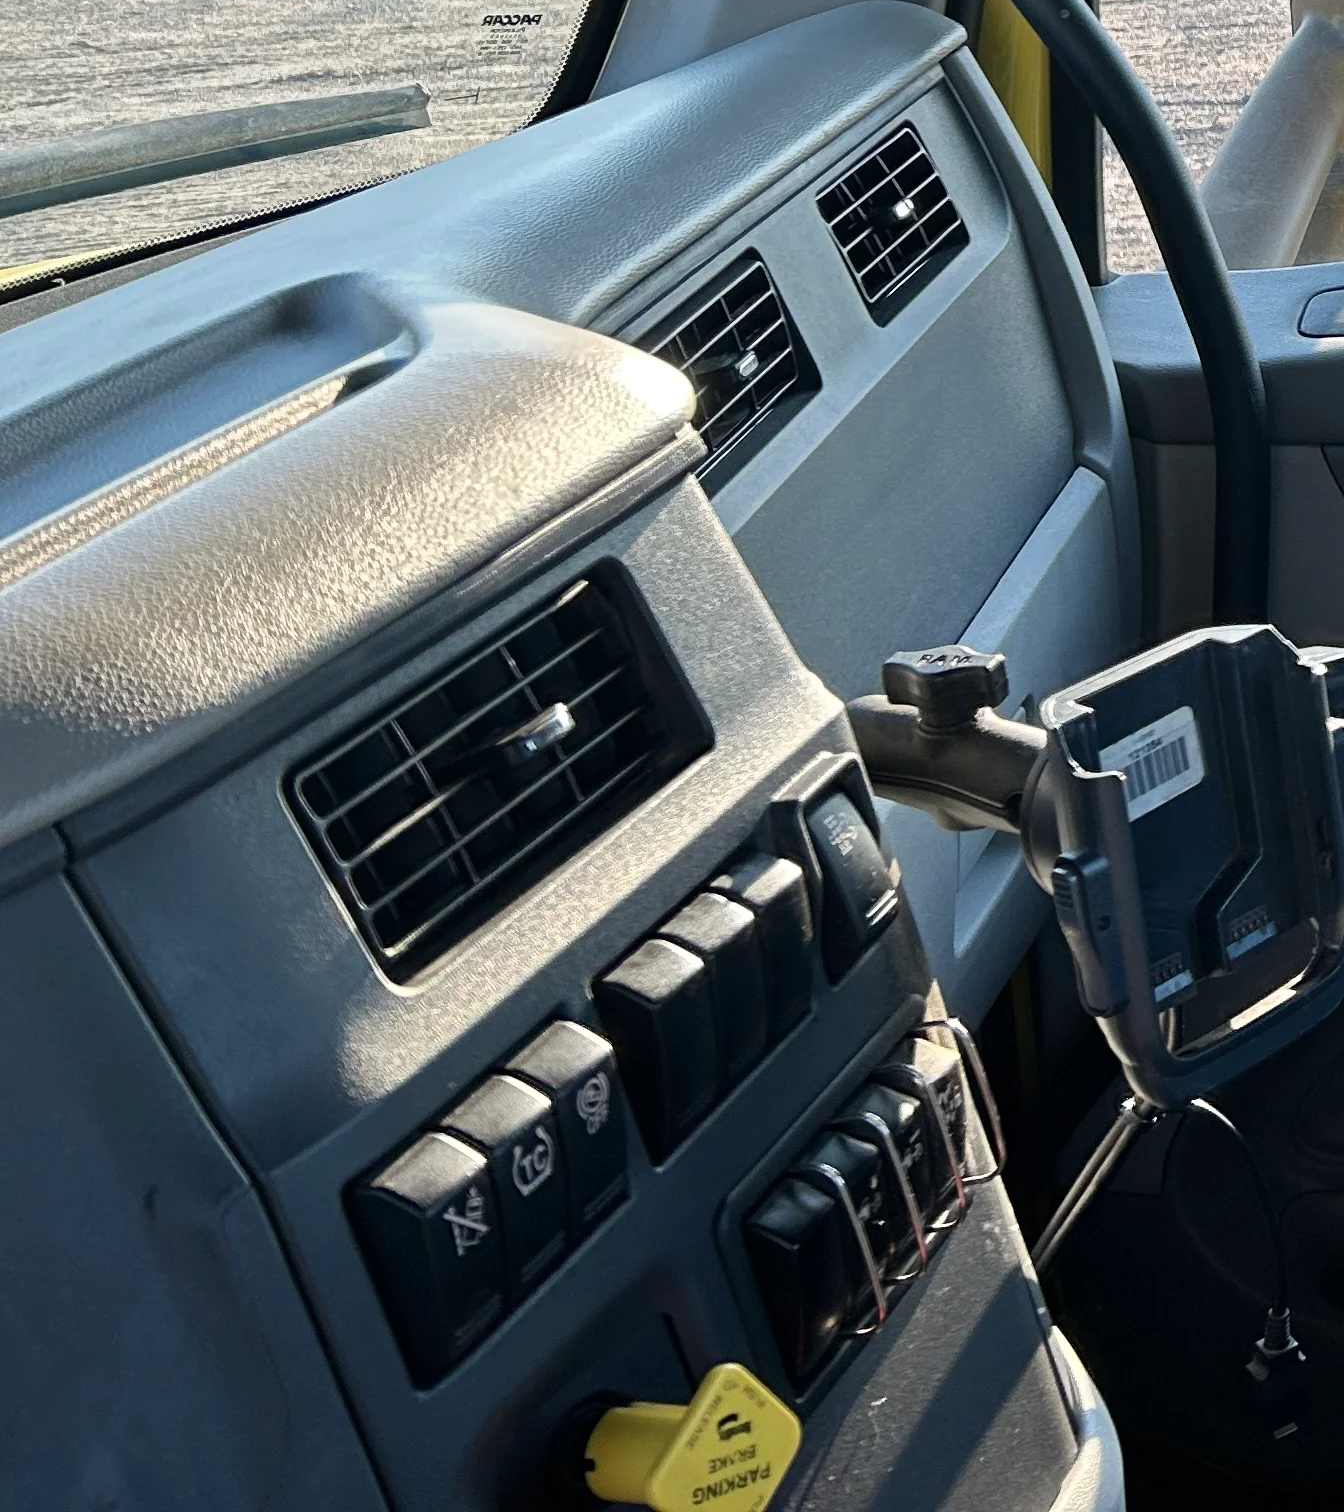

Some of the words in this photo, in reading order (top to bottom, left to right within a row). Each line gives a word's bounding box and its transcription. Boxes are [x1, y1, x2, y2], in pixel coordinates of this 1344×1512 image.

[917, 653, 975, 665] RAM
[520, 1144, 547, 1181] TC
[692, 1461, 771, 1506] PARKING
